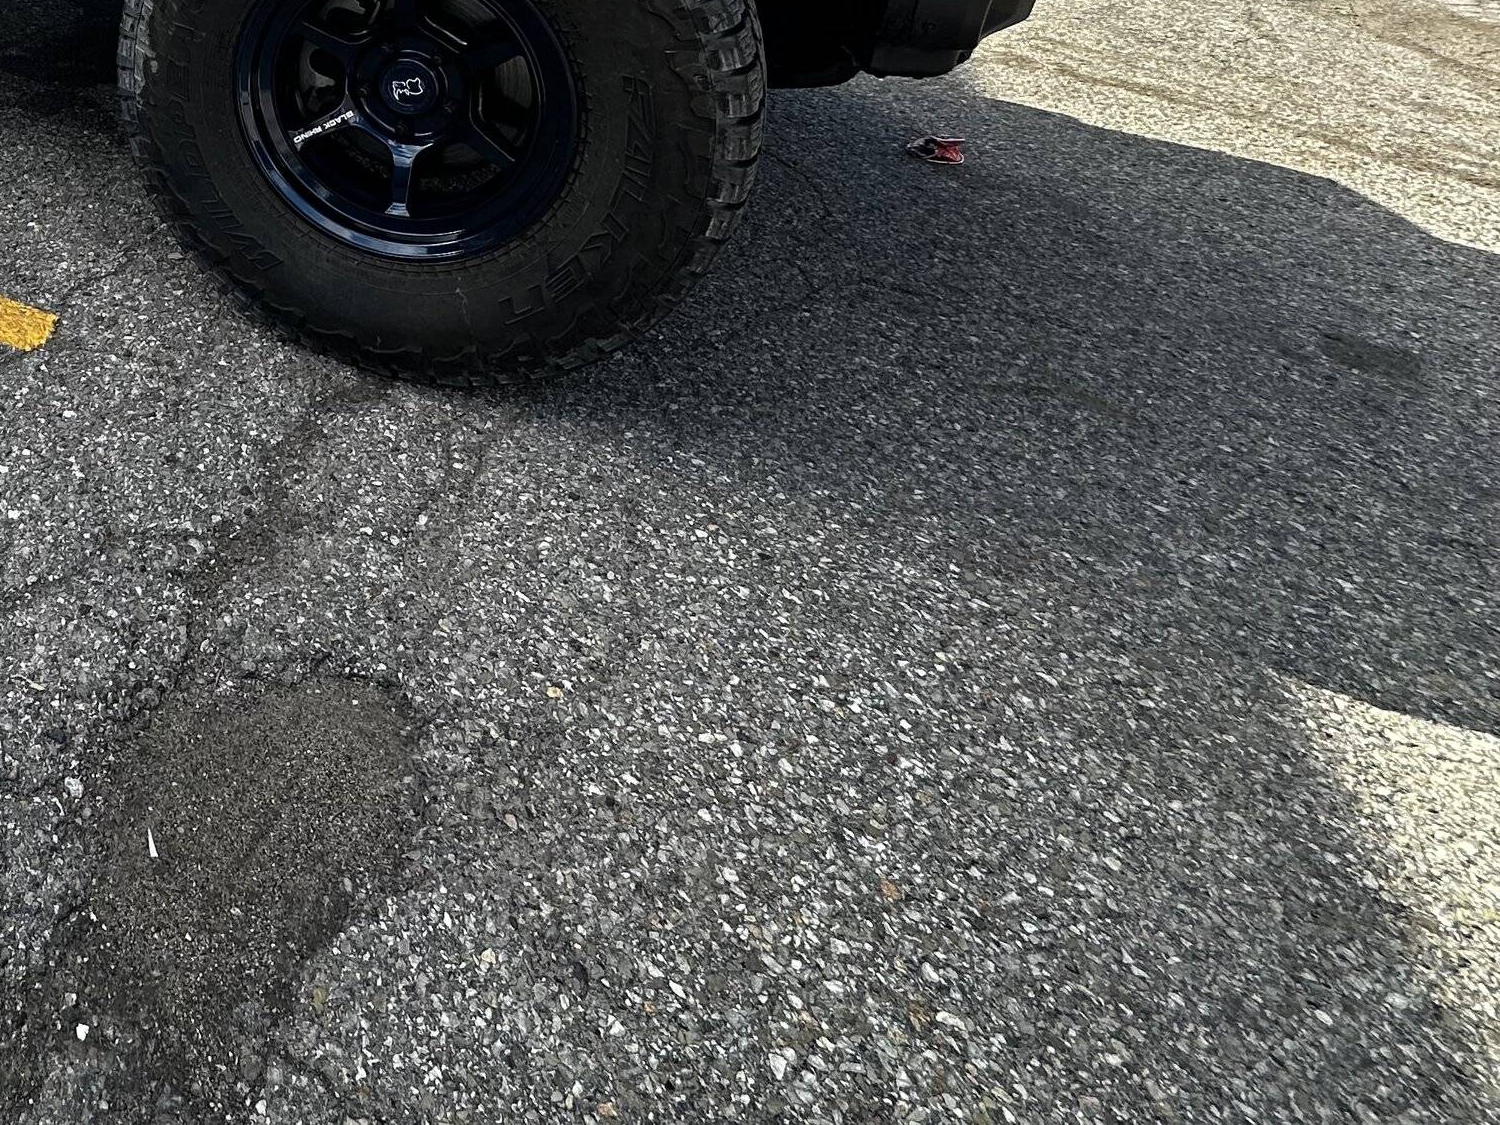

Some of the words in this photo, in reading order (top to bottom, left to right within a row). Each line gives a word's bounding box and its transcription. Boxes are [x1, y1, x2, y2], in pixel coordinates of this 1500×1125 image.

[323, 110, 354, 130] BLACK
[293, 125, 323, 143] RHINO
[494, 73, 654, 327] FALKEN
